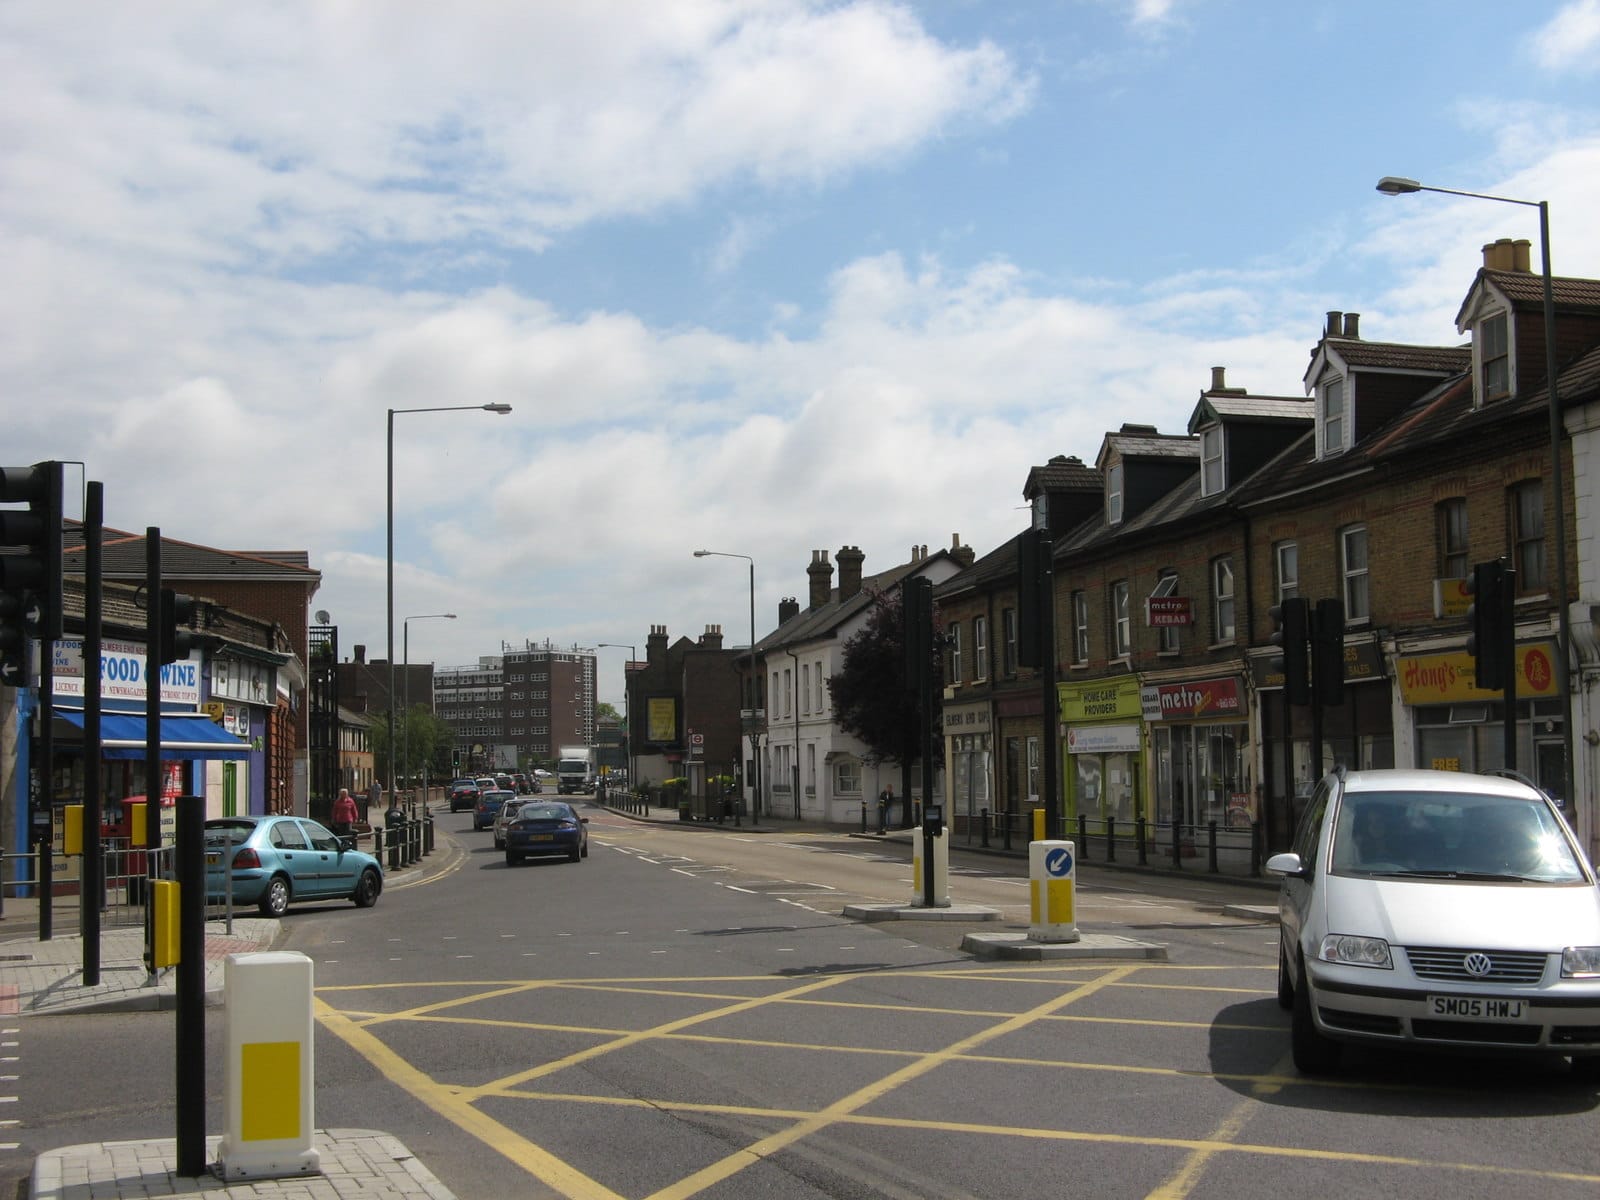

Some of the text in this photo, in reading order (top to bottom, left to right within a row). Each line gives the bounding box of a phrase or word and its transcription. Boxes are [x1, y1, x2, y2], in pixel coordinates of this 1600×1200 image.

[1155, 615, 1187, 624] KEBAB
[100, 656, 196, 687] FOOD WINE
[1405, 660, 1455, 693] Hong's
[1084, 702, 1117, 715] PROVIDERS
[1162, 686, 1202, 710] metro
[1434, 998, 1522, 1018] SM05 HWJ
